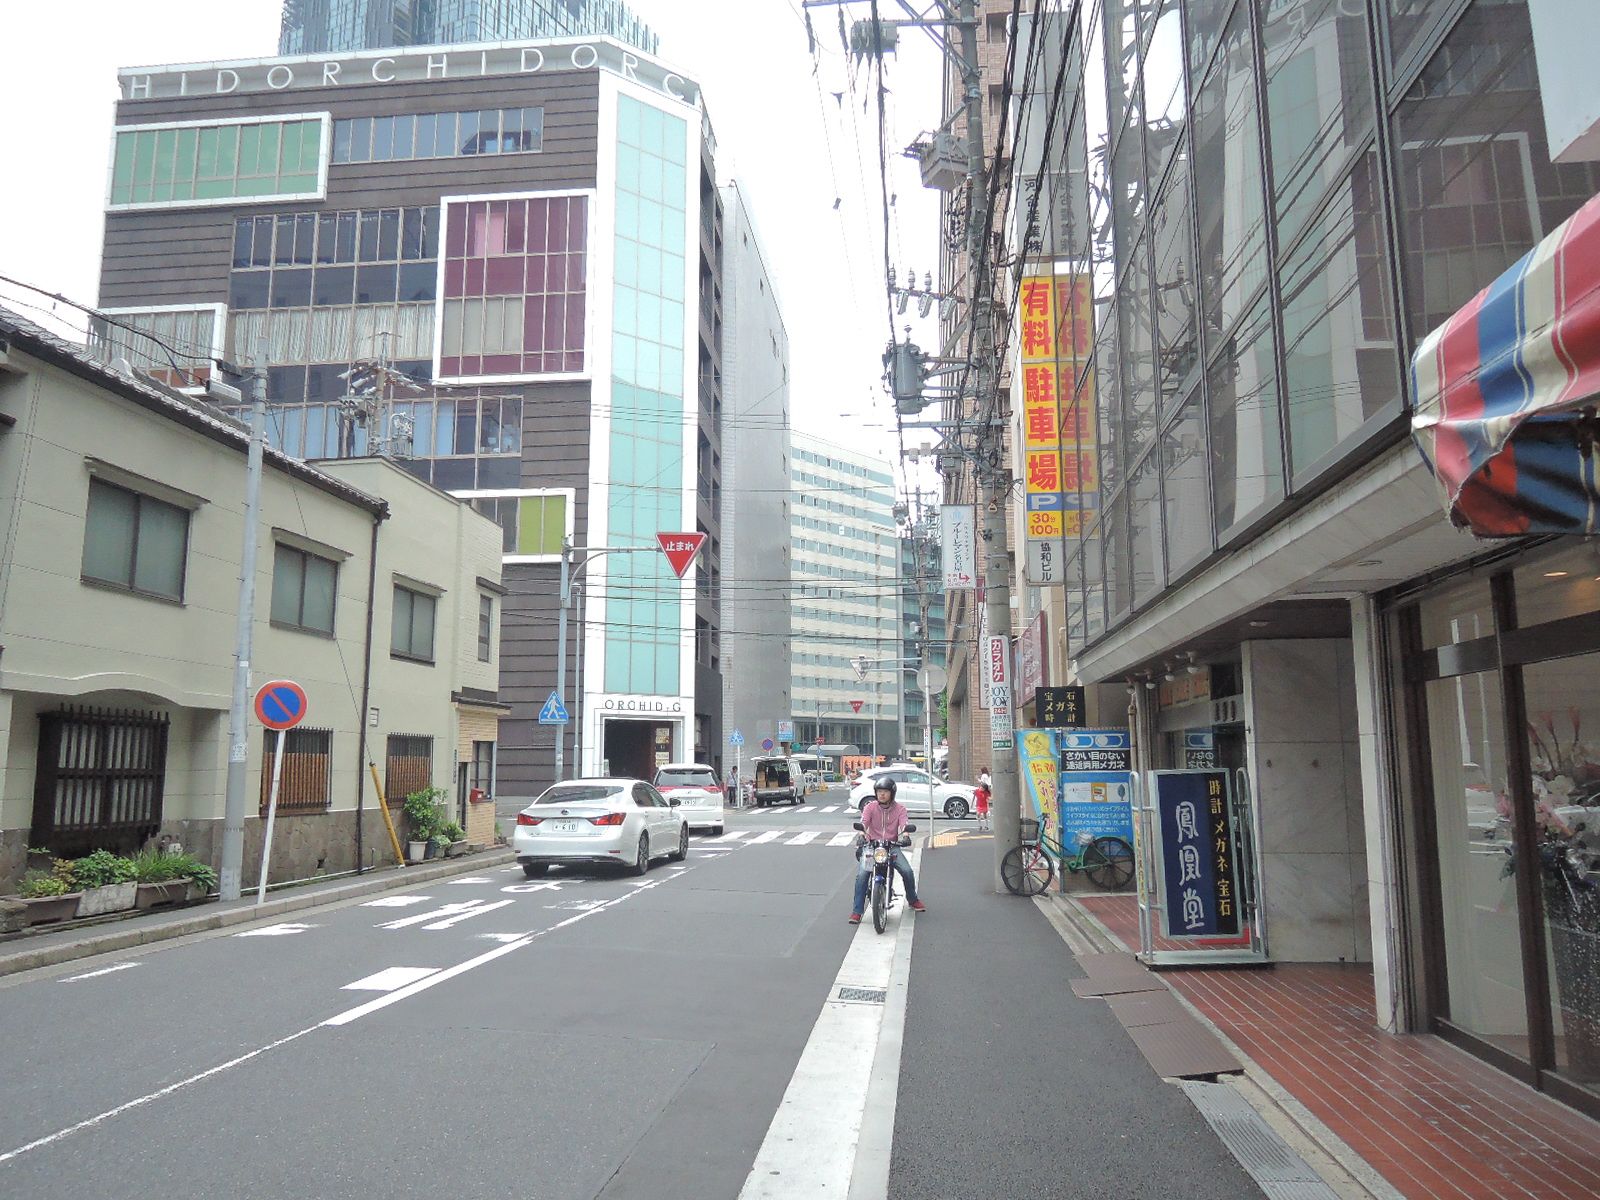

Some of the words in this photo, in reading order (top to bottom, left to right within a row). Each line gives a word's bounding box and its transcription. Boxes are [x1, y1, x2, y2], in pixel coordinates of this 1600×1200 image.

[1022, 282, 1058, 490] 有料駐車場
[1031, 495, 1057, 510] P
[666, 541, 695, 552] 止まれ
[1030, 524, 1059, 535] 100円
[1040, 542, 1052, 581] 協和ビル
[992, 640, 1003, 681] カラオケ
[1044, 701, 1077, 712] メガネ
[1065, 751, 1125, 760] さかい目のない
[1065, 760, 1125, 770] 遠近両用メガネ
[1209, 779, 1223, 815] 時計
[1214, 819, 1229, 873] メガネ
[1175, 801, 1206, 930] 鳳凰堂
[1217, 878, 1232, 917] 宝石
